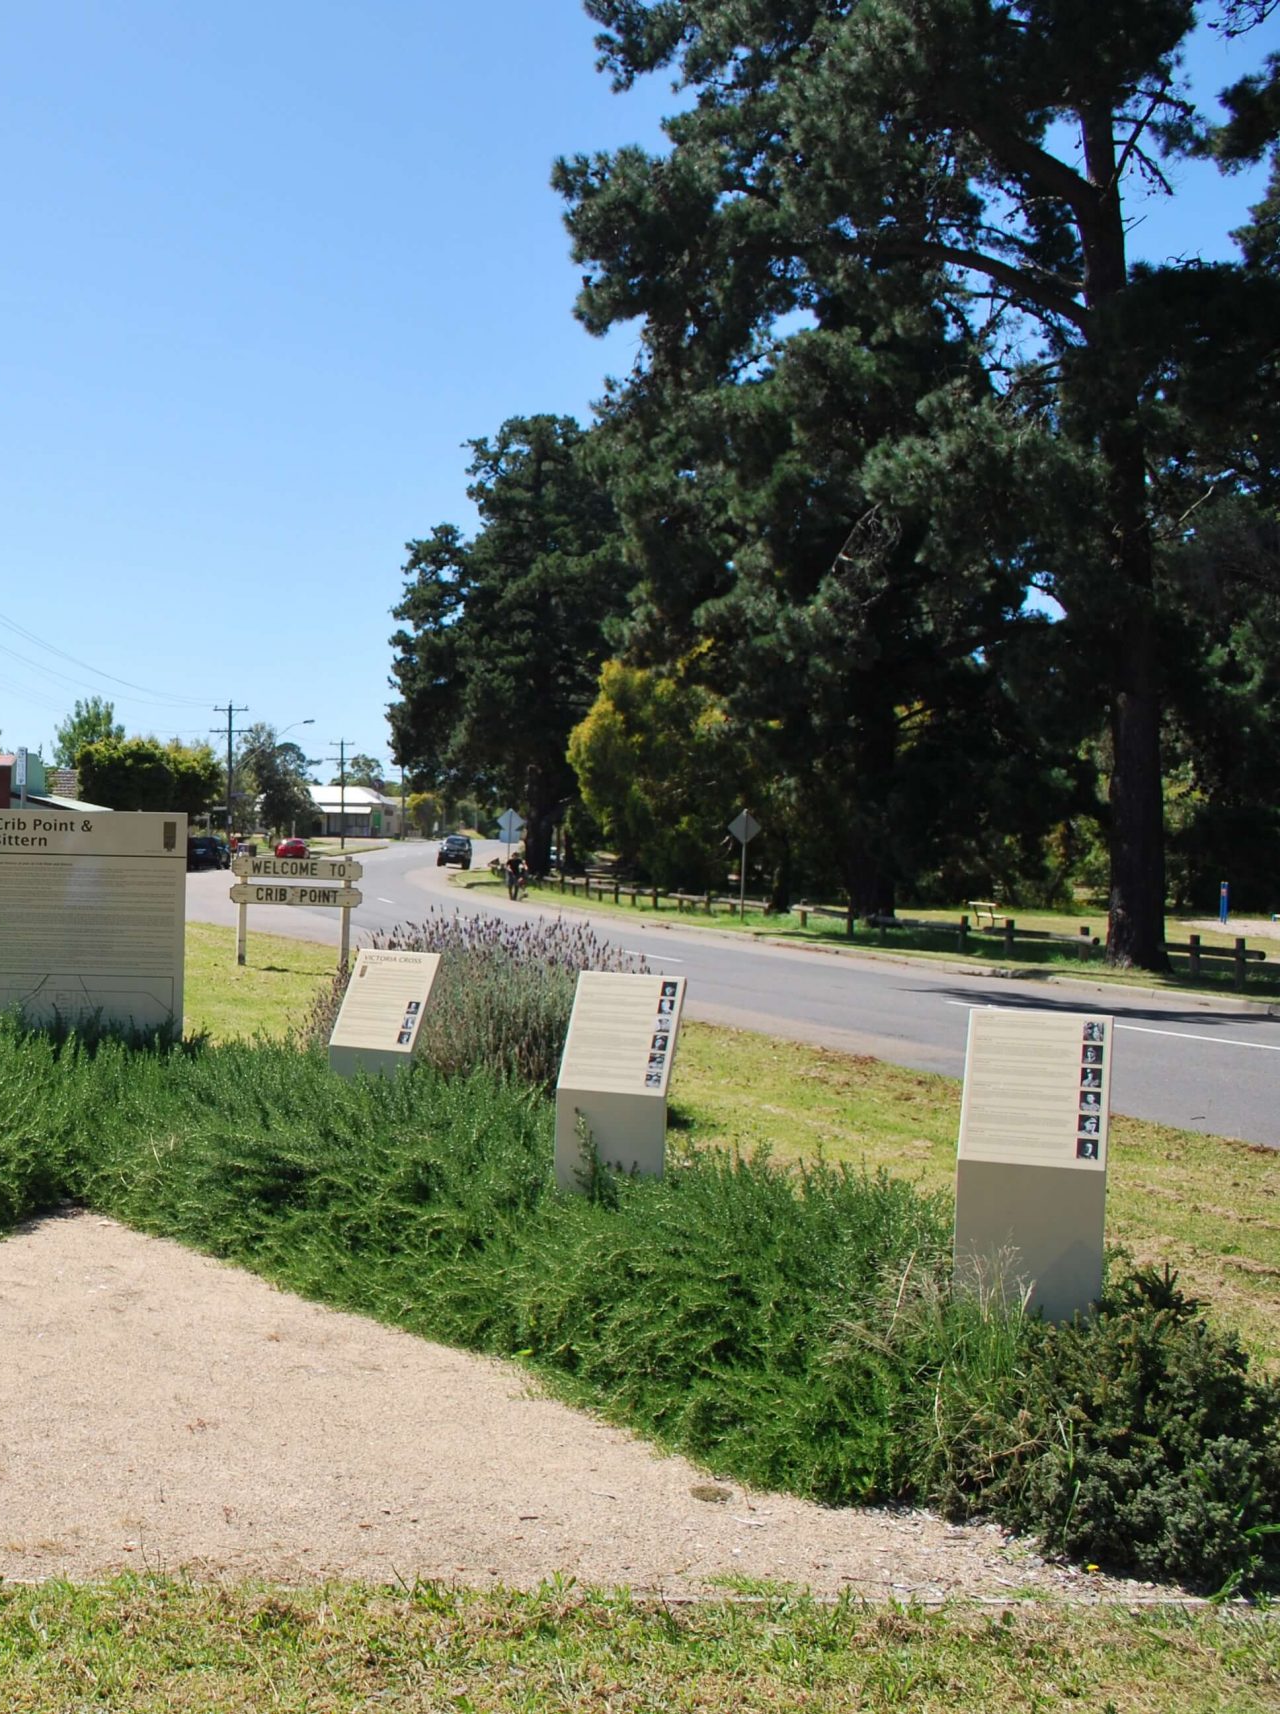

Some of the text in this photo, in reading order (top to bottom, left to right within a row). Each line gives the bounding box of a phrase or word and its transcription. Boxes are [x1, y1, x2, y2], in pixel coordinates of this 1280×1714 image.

[33, 819, 75, 832] Point
[81, 820, 93, 832] &
[252, 860, 346, 877] WELCOME TO
[256, 887, 339, 904] CRIB POINT
[398, 956, 423, 964] CROSS
